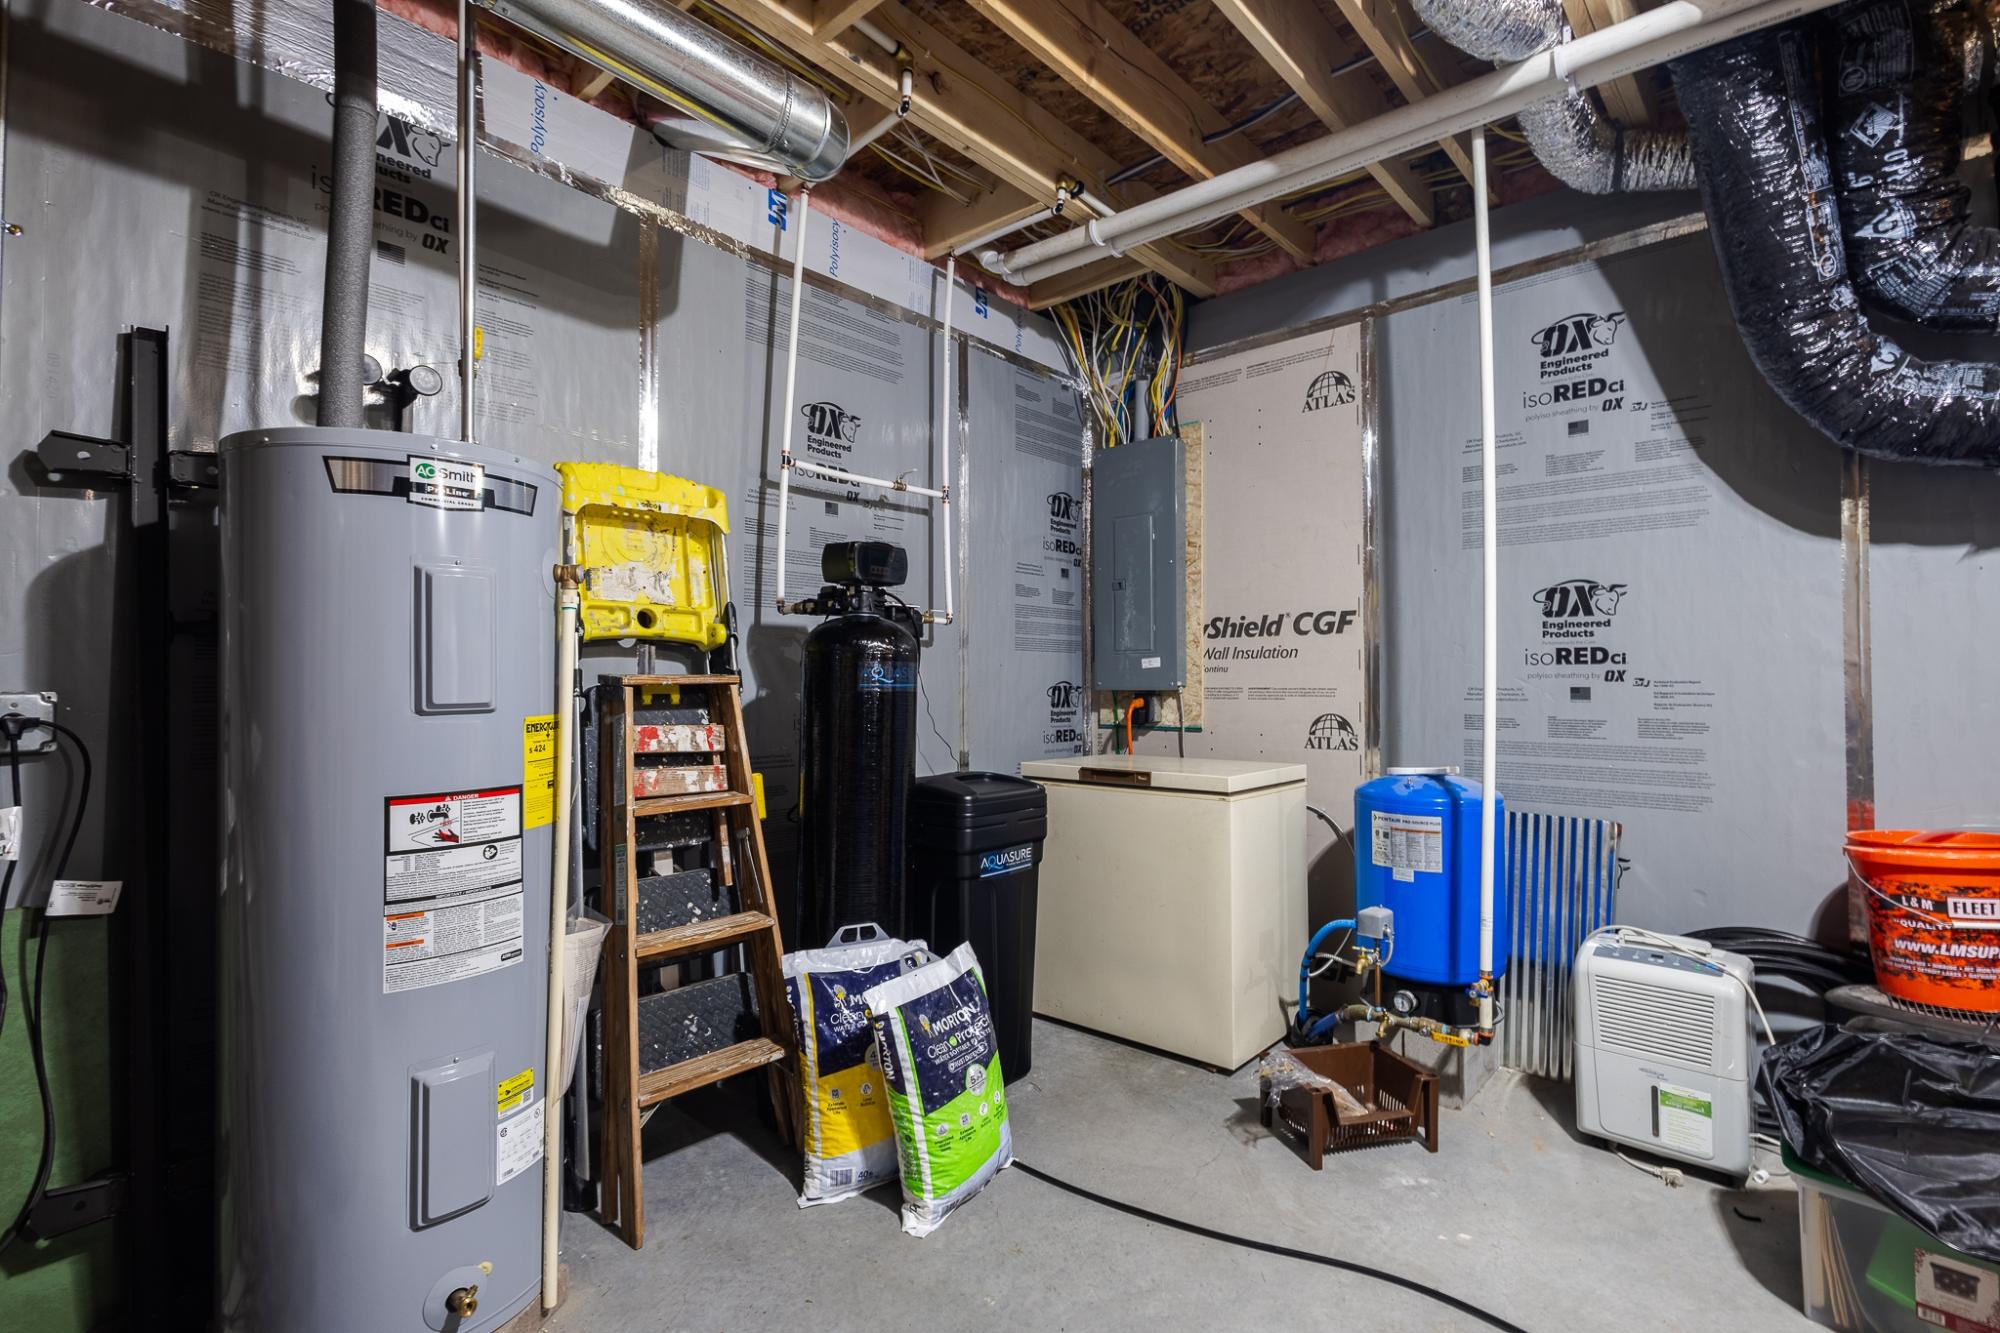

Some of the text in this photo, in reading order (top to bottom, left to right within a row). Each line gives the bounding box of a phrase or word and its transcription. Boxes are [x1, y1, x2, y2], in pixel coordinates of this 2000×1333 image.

[529, 79, 548, 154] Polyisocy
[376, 152, 432, 179] neered
[422, 233, 449, 254] OX
[829, 217, 841, 277] Polyisocy
[1541, 317, 1596, 357] OX
[1540, 349, 1609, 369] Engineered
[1540, 362, 1592, 379] Products
[1302, 389, 1356, 413] ATLAS
[1522, 378, 1624, 408] isoREDci
[1602, 396, 1625, 412] OX
[807, 403, 845, 440] OX
[807, 434, 852, 452] Engineered
[807, 444, 842, 459] Products
[1051, 496, 1072, 520] OX
[1050, 518, 1077, 529] Engineered
[1050, 526, 1071, 535] Products
[1541, 584, 1597, 618] OX
[1292, 610, 1357, 635] CGF
[1542, 619, 1611, 630] Engineered
[1542, 630, 1595, 638] Products
[1232, 645, 1298, 659] Insulation
[1525, 647, 1626, 665] isoREDci
[1203, 665, 1229, 673] ontinu
[1604, 669, 1626, 682] OX
[1051, 685, 1073, 708] OX
[1050, 709, 1077, 718] Engineered
[1050, 716, 1072, 724] Products
[1304, 736, 1358, 750] ATLAS
[981, 848, 1032, 868] AQUASURE
[1911, 898, 1919, 908] &
[1921, 899, 1933, 911] M
[1953, 902, 1996, 915] FLEET
[932, 1002, 976, 1035] MORTON
